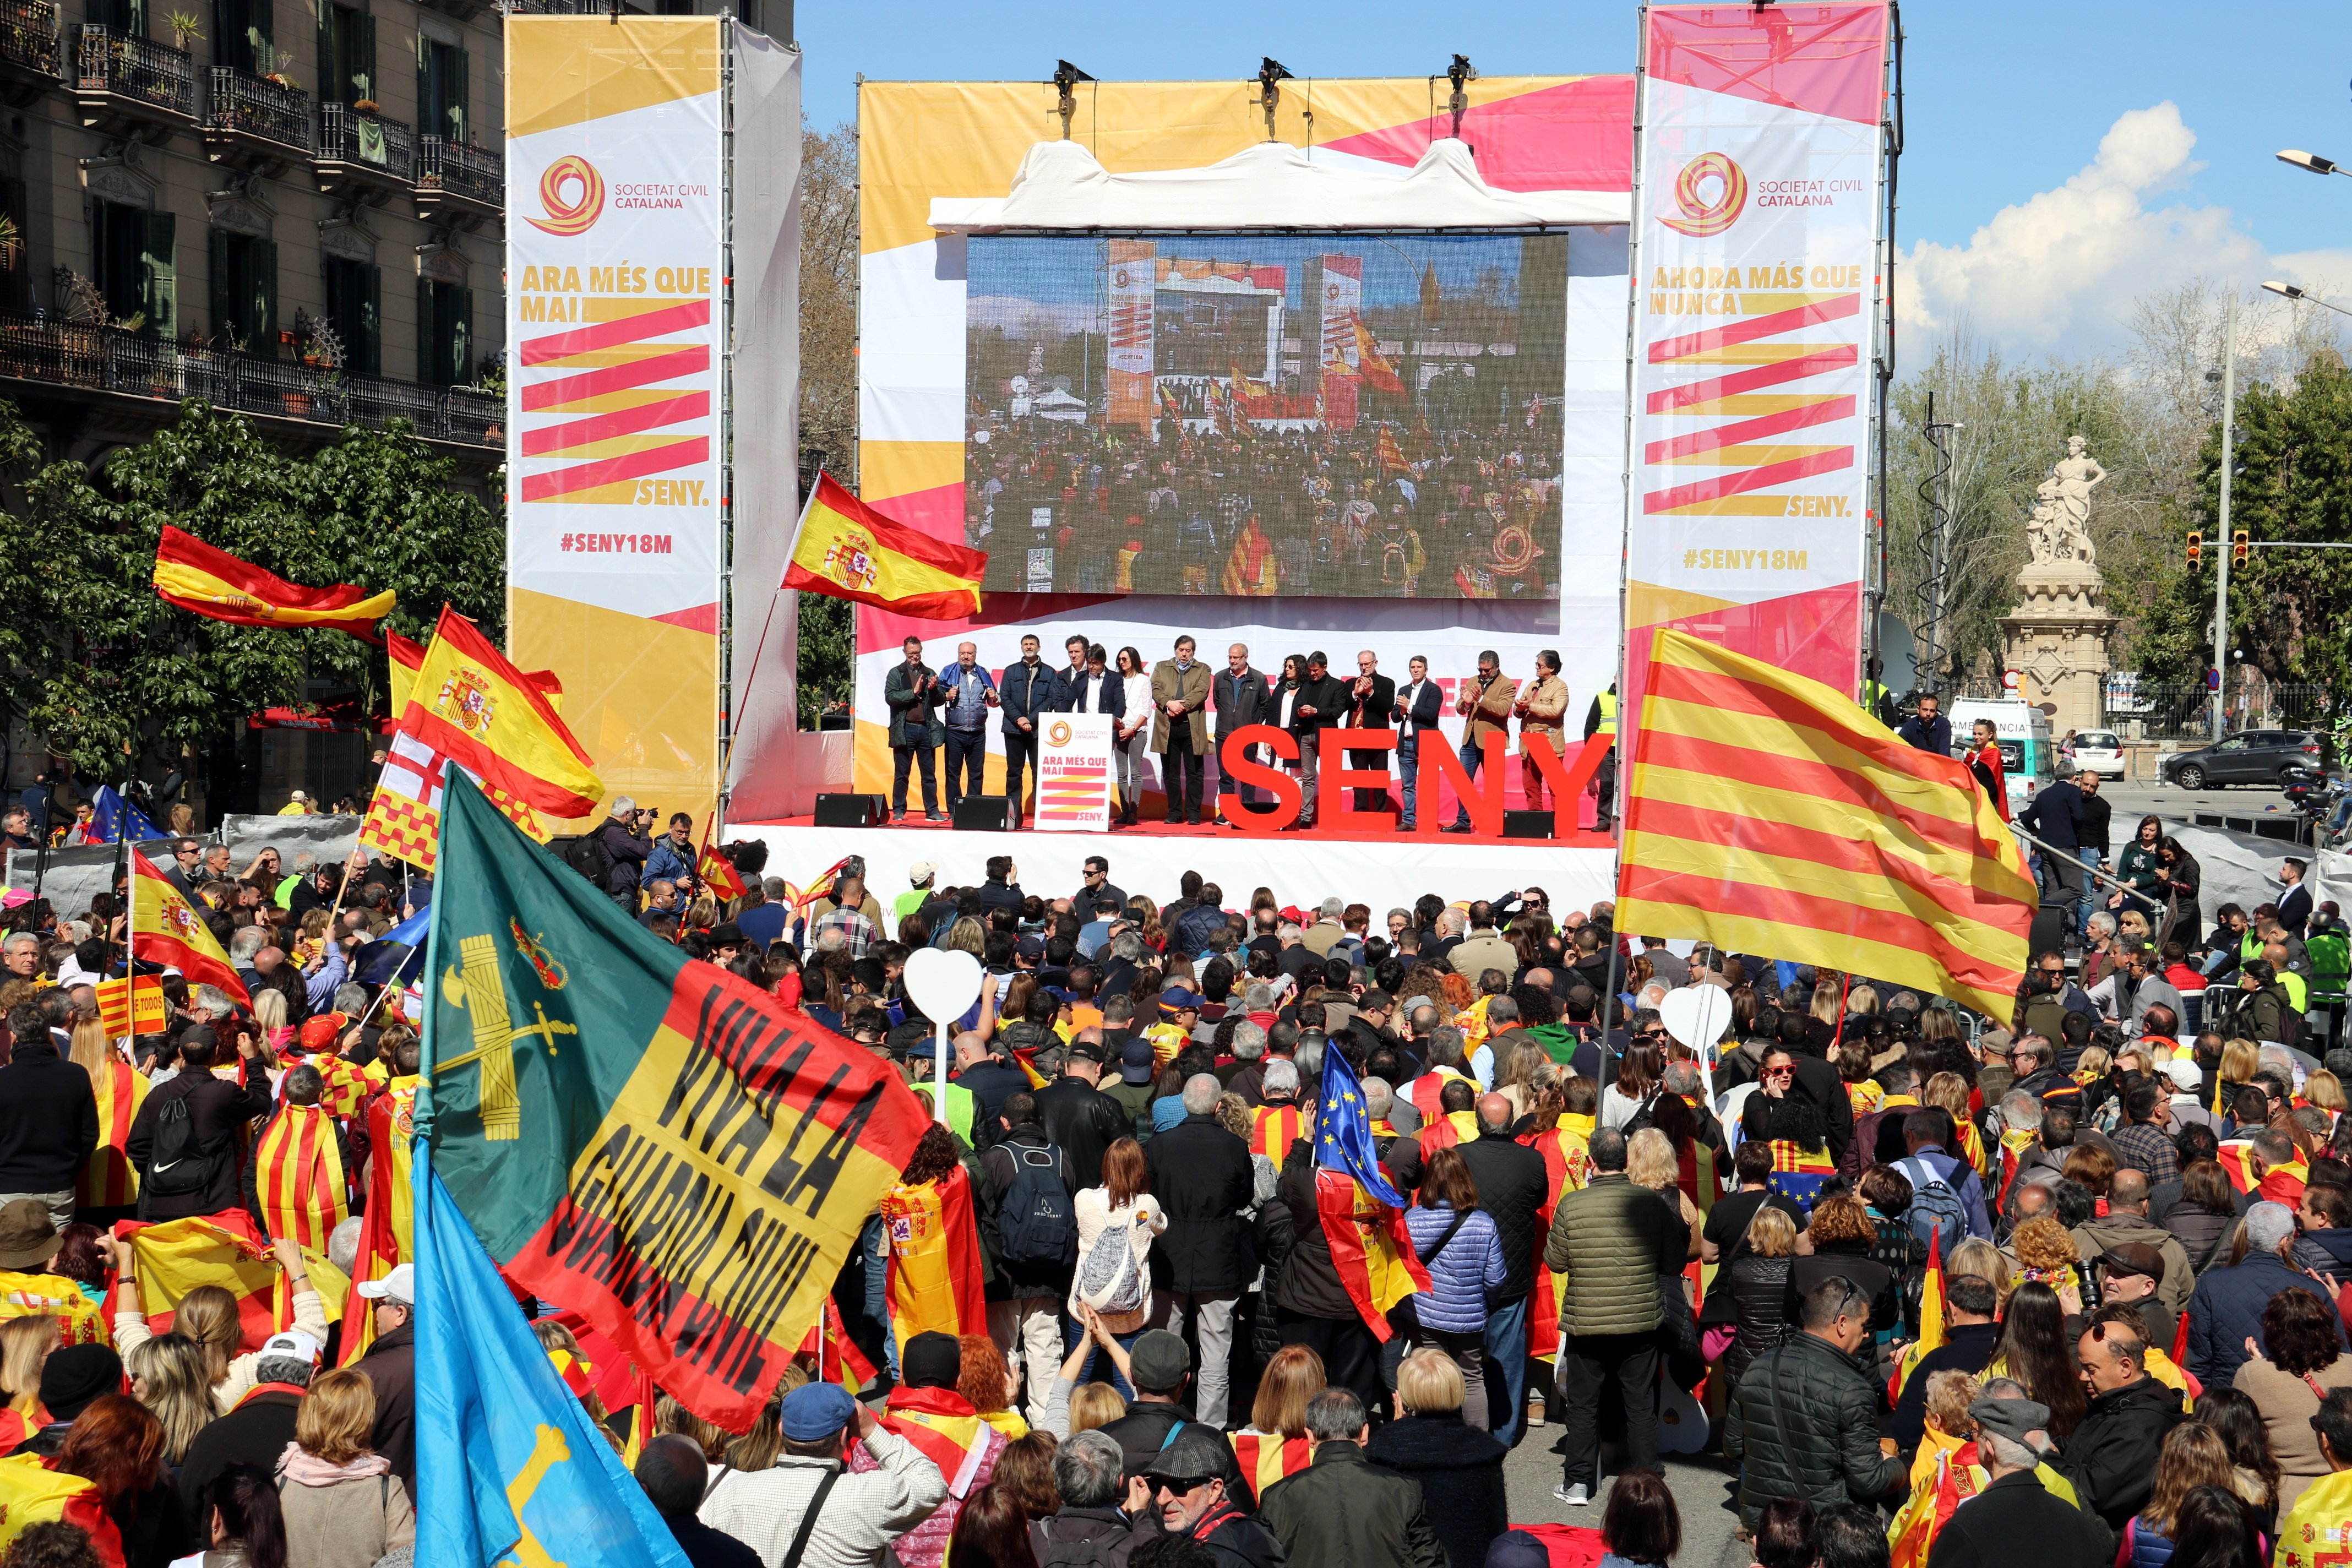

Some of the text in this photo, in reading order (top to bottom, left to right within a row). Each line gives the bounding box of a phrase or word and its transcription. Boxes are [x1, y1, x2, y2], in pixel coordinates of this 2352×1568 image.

[615, 184, 709, 197] SOCIETAT CIVIL
[1758, 179, 1863, 193] SOCIETAT CIVIL
[614, 198, 683, 209] CATALANA
[1757, 194, 1833, 207] CATALANA
[520, 259, 710, 294] ARA MÉS QUE
[1651, 260, 1861, 290] AHORA MÁS QUE
[520, 296, 578, 322] MAI
[1649, 293, 1737, 315] NUNCA
[636, 478, 710, 507] SENY.
[1787, 495, 1852, 518] SENY.
[560, 533, 672, 554] #SENY18M
[1683, 548, 1807, 570] #SENY18M
[1042, 755, 1107, 766] ARA MÉS QUE
[1042, 766, 1061, 775] MAI
[1218, 723, 1616, 838] SENY
[1079, 812, 1104, 821] SENY.
[140, 995, 163, 1011] TODOS
[656, 983, 887, 1220] VIVA LA
[546, 1124, 821, 1396] GUARDIA CIVIL
